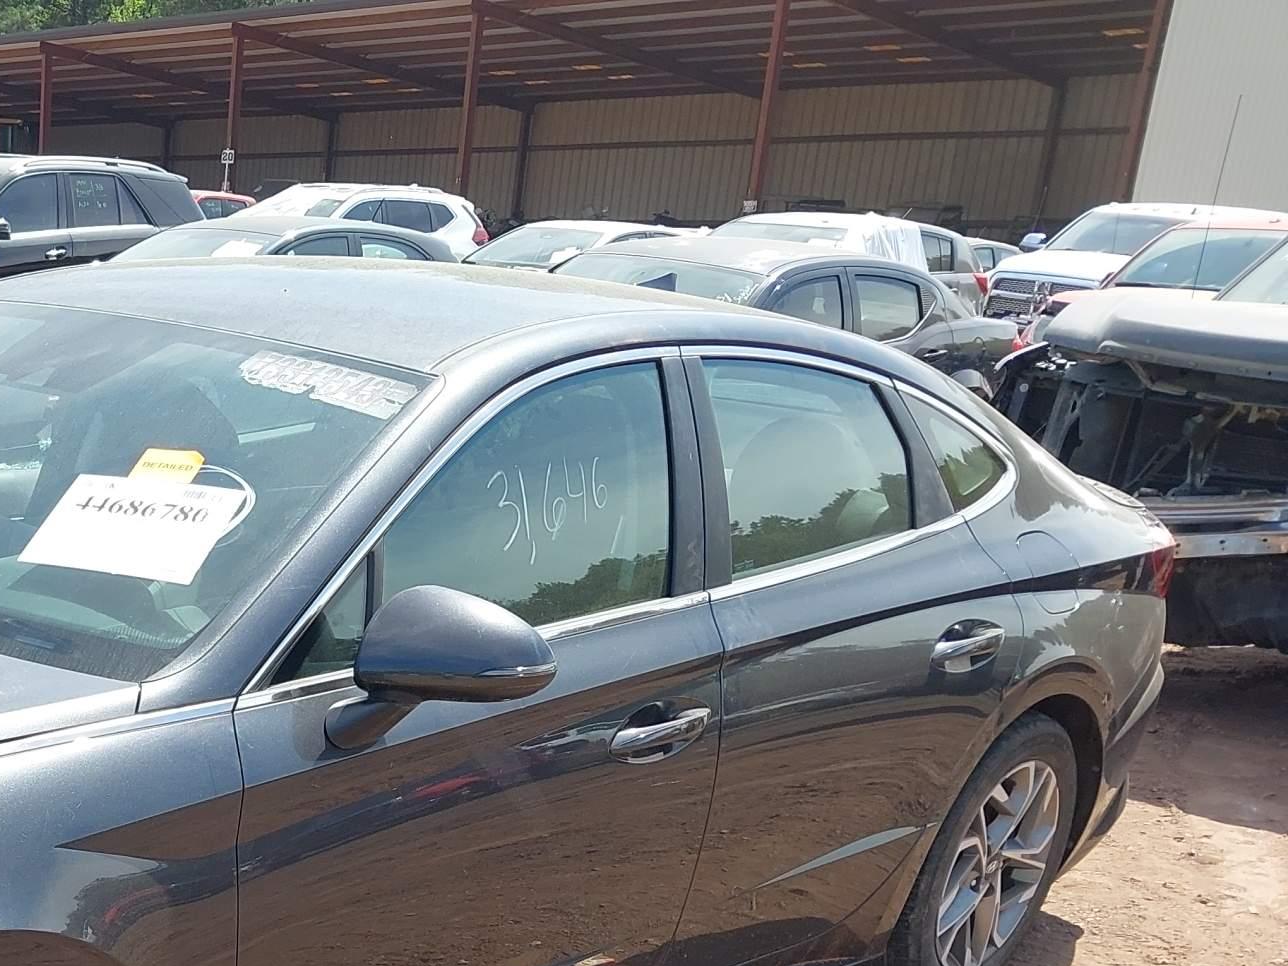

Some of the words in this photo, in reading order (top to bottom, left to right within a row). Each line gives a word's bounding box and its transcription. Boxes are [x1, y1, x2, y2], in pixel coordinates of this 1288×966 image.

[222, 151, 234, 162] 20
[141, 460, 195, 472] DETAILED
[75, 495, 210, 523] 44686780
[486, 455, 609, 566] 31,646
